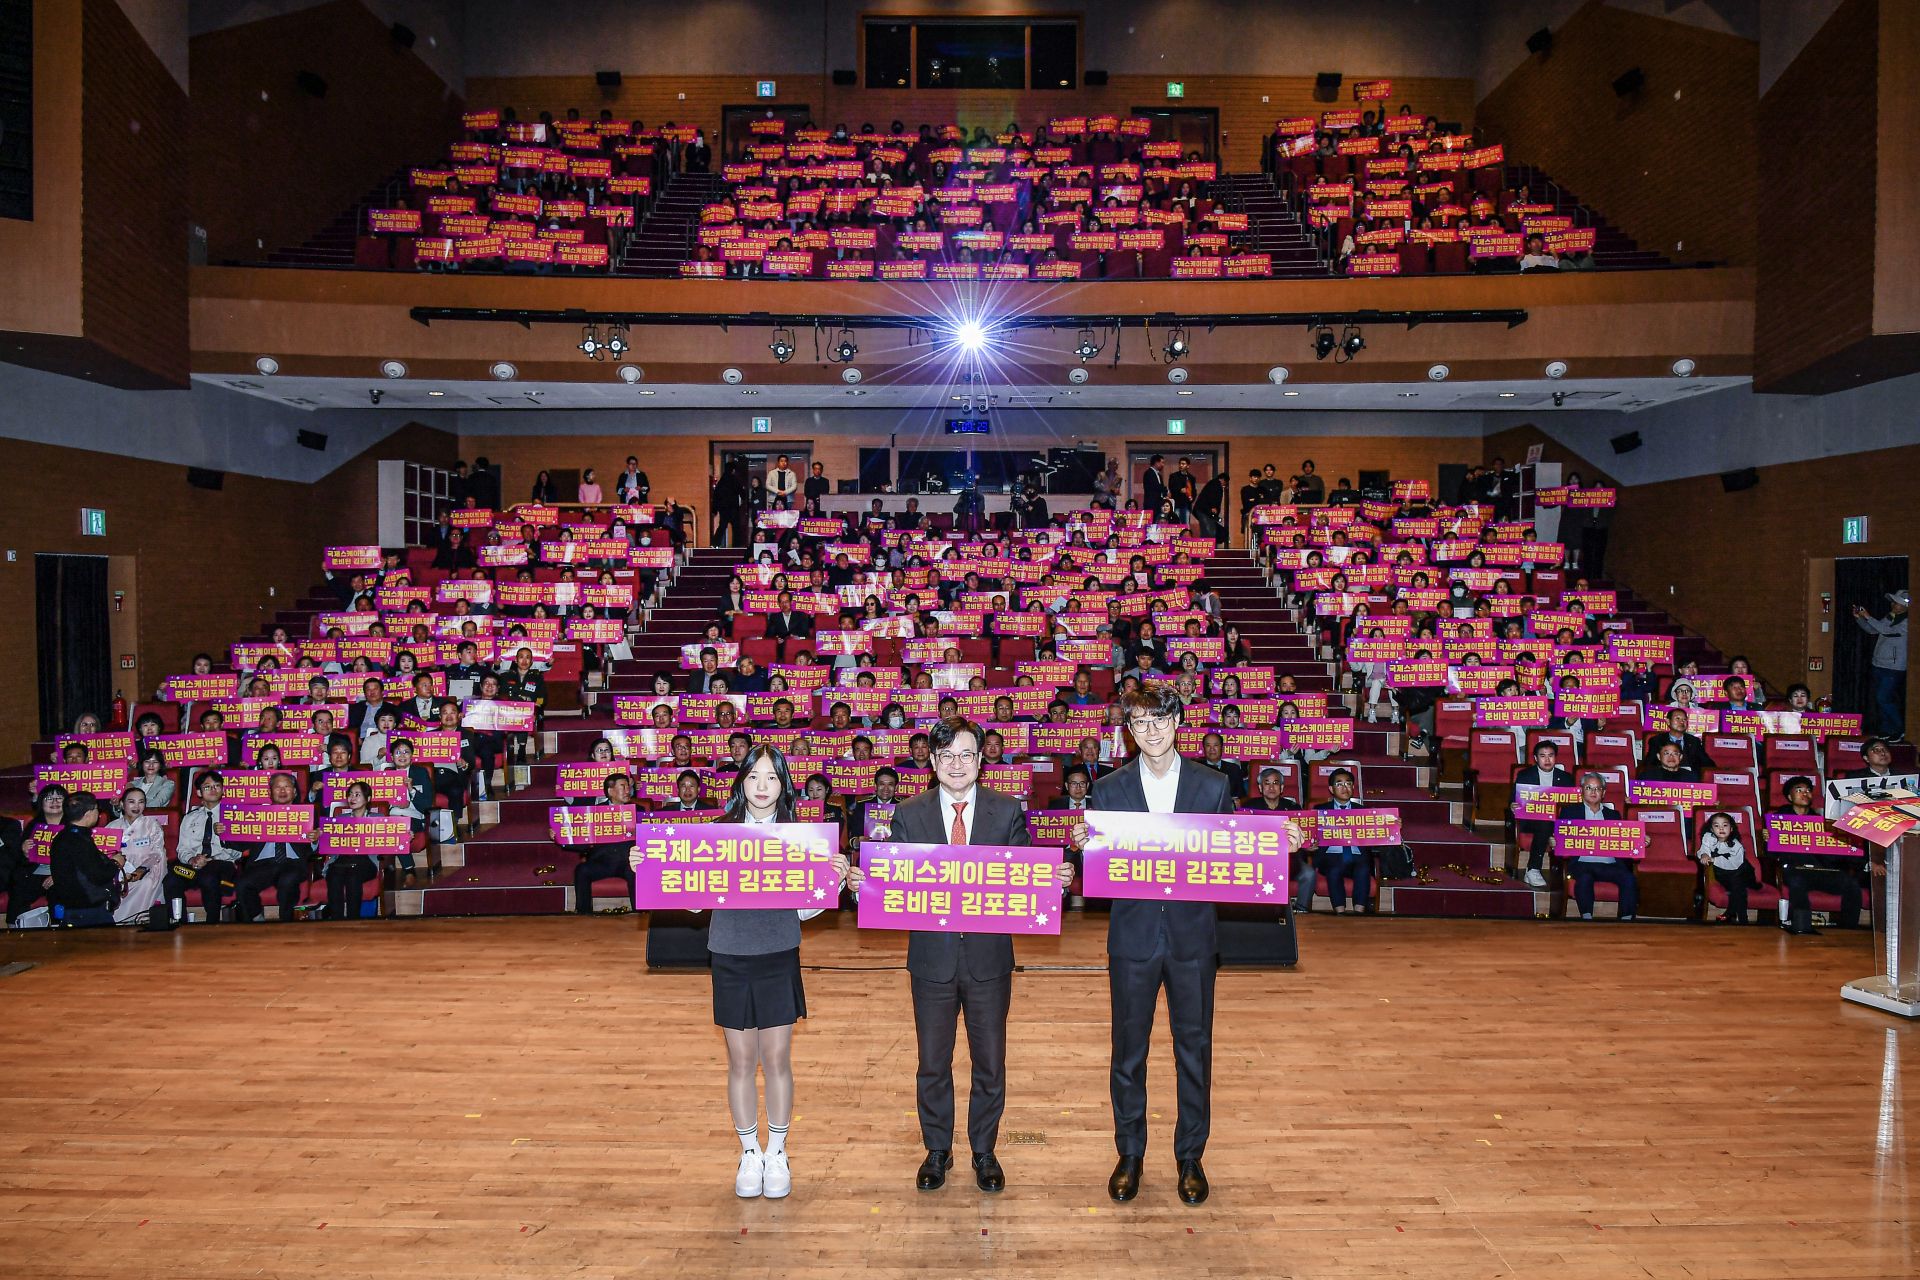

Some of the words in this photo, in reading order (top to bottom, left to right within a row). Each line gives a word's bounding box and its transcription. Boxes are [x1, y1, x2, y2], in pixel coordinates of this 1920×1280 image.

[1612, 640, 1670, 648] 국제스케이트장은
[1618, 649, 1640, 657] 준비된
[1018, 665, 1074, 673] 국제스케이트장은
[1389, 664, 1447, 672] 국제스케이트장은
[1394, 674, 1416, 682] 준비된
[1418, 674, 1442, 682] 김포로!
[175, 690, 199, 698] 준비된
[825, 692, 886, 700] 국제스케이트장은
[1559, 694, 1617, 702] 국제스케이트장은
[1479, 702, 1544, 710] 국제스케이트장은
[1564, 704, 1587, 712] 준비된
[1589, 704, 1613, 712] 김포로!
[1243, 715, 1269, 723] 김포로!
[1485, 712, 1510, 720] 준비된
[1512, 712, 1539, 720] 김포로!
[1032, 728, 1097, 736] 국제스케이트장은
[1284, 724, 1349, 732] 국제스케이트장은
[1038, 739, 1061, 747] 준비된
[1289, 735, 1314, 743] 준비된
[1316, 735, 1344, 743] 김포로!
[187, 749, 218, 758] 김포로!
[284, 750, 313, 758] 김포로!
[1243, 746, 1271, 755] 김포로!
[39, 769, 123, 781] 국제스케이트장은
[82, 782, 116, 792] 김포로!
[564, 781, 587, 790] 준비된
[832, 779, 857, 788] 준비된
[994, 783, 1023, 791] 김포로!
[646, 786, 672, 794] 준비된
[706, 790, 730, 799] 준비된
[1633, 786, 1713, 799] 국제스케이트장은
[1526, 804, 1555, 814] 준비된
[223, 811, 310, 821] 국제스케이트장은
[230, 824, 263, 835] 준비된
[267, 824, 302, 835] 김포로!
[323, 824, 407, 834] 국제스케이트장은
[593, 826, 626, 836] 김포로!
[1037, 829, 1065, 838] 준비된
[1323, 829, 1353, 838] 준비된
[1357, 829, 1389, 838] 김포로!
[1558, 825, 1641, 838] 국제스케이트장은
[330, 836, 361, 847] 준비된
[365, 836, 399, 847] 김포로!
[1564, 839, 1595, 849] 준비된
[1599, 840, 1633, 850] 김포로!
[1779, 834, 1811, 846] 준비된
[645, 839, 830, 863] 국제스케이트장은
[869, 858, 1053, 886] 국제스케이트장은
[1108, 858, 1176, 882] 준비된
[1186, 860, 1264, 885] 김포로!
[661, 869, 729, 892] 준비된
[738, 869, 814, 892] 김포로!
[883, 890, 951, 914] 준비된
[961, 891, 1037, 916] 김포로!
